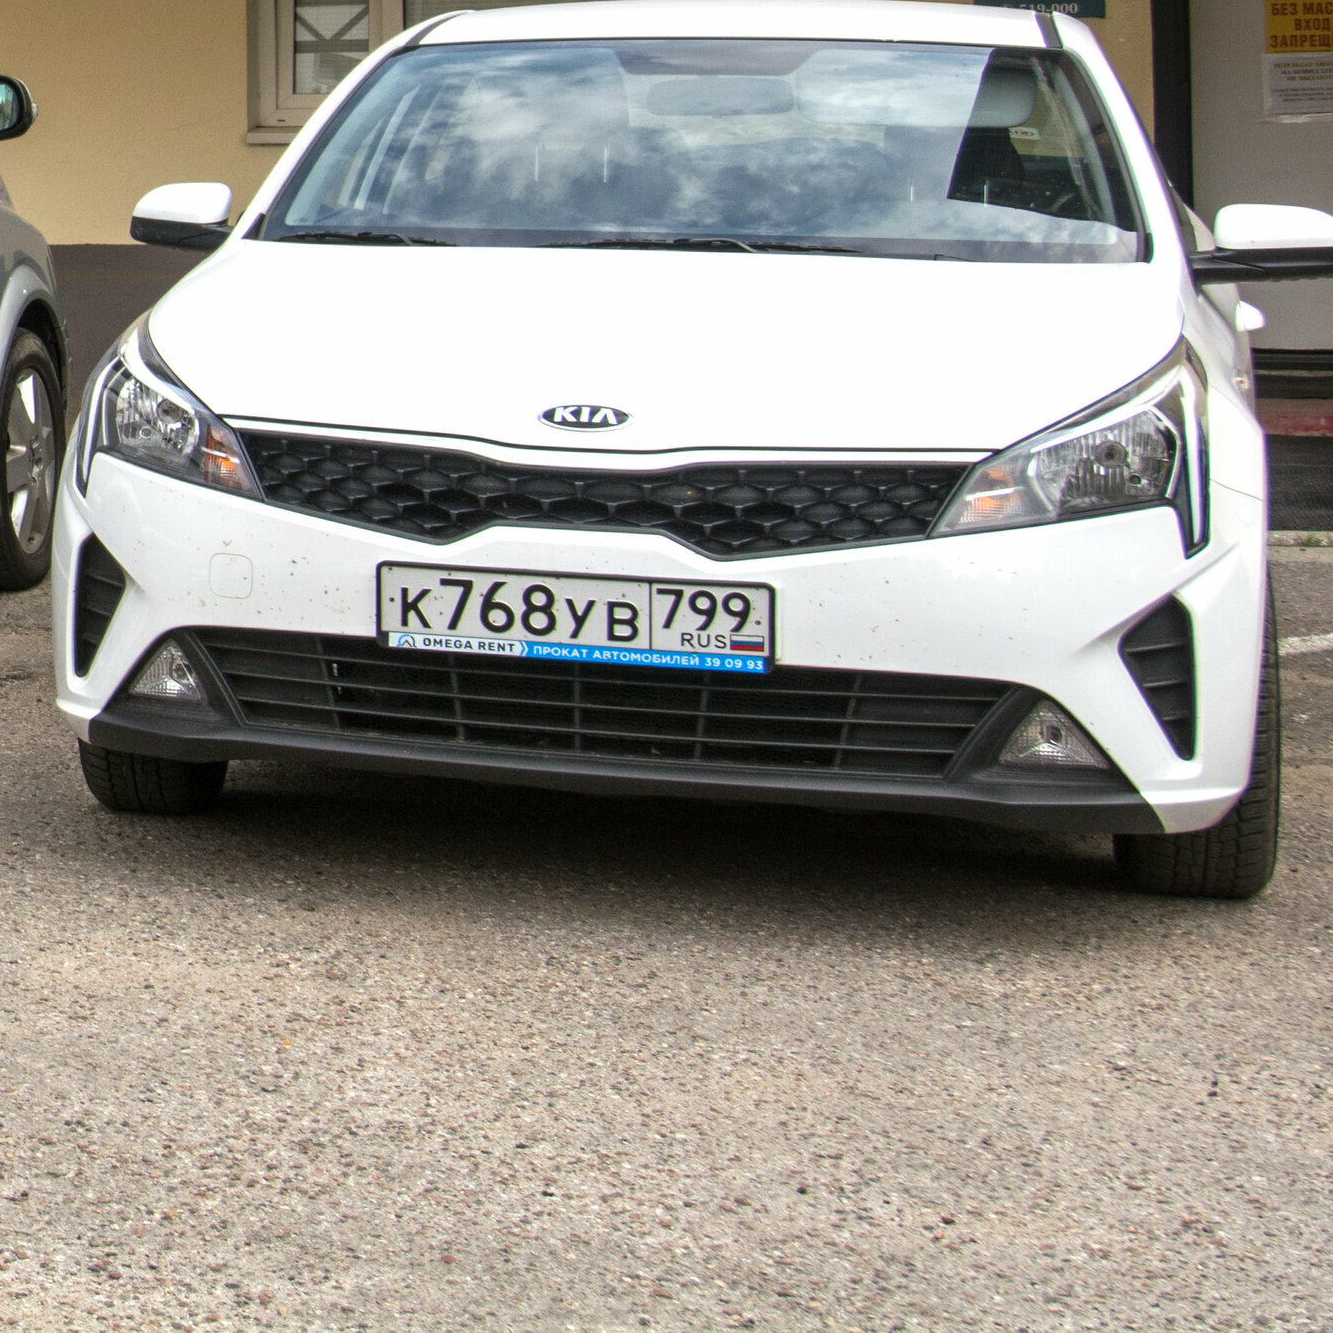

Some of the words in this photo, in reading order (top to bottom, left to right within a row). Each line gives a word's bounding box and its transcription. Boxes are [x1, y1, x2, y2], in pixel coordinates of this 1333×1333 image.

[1271, 2, 1298, 16] БЕЗ
[1294, 18, 1331, 31] ВХОД
[1270, 34, 1333, 48] ЗАПРЕЩ
[553, 407, 618, 425] KIA
[400, 578, 639, 641] К768УВ
[656, 588, 751, 632] 799
[423, 637, 473, 649] OMEGA
[478, 641, 515, 653] RENT
[681, 632, 727, 649] RUS
[533, 646, 588, 658] ПРОКАТ
[593, 650, 699, 666] АВТОМОБИЛЕЙ
[704, 657, 721, 667] 39
[724, 659, 742, 668] 09
[746, 660, 764, 670] 93
